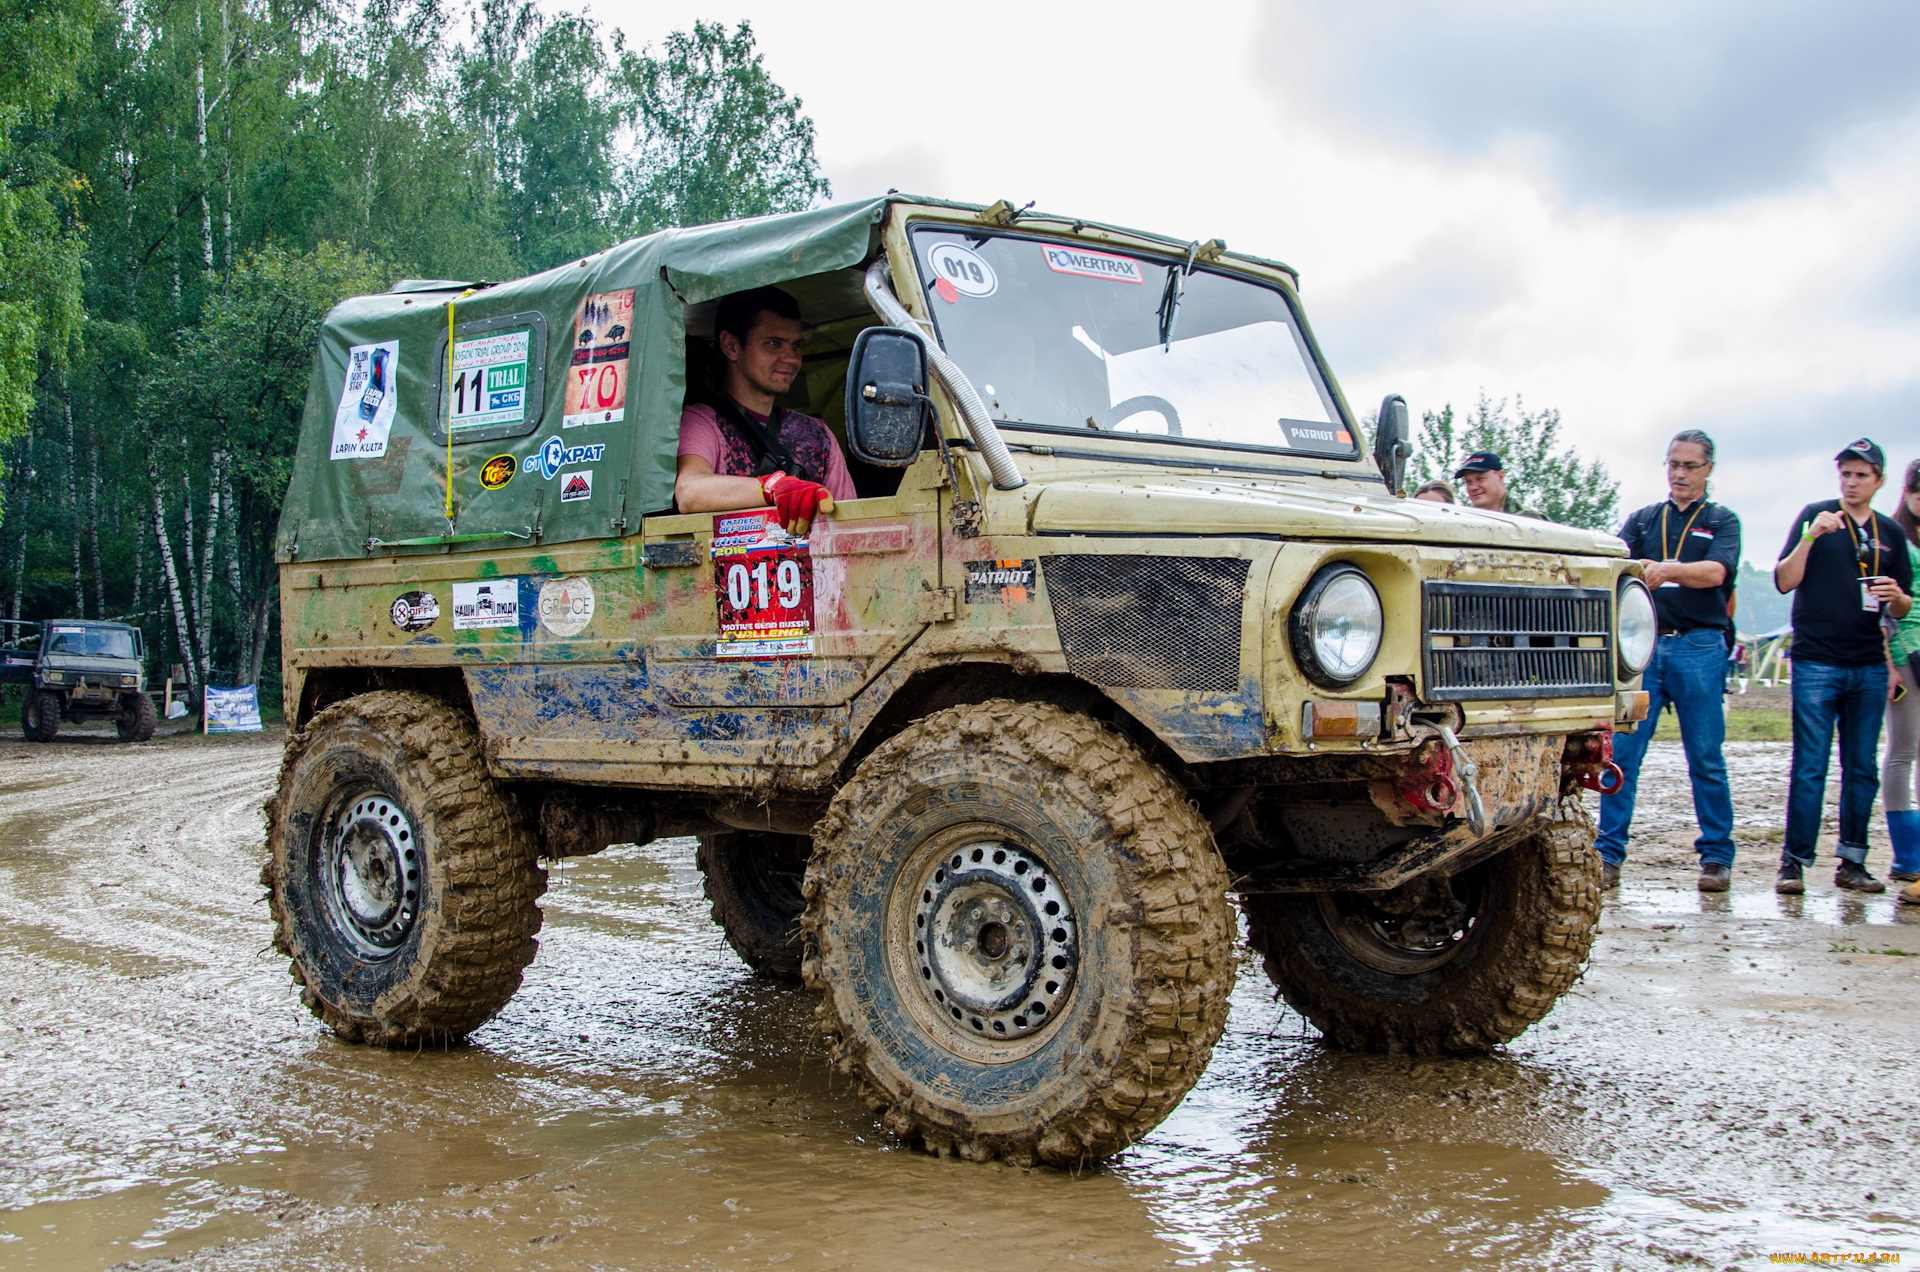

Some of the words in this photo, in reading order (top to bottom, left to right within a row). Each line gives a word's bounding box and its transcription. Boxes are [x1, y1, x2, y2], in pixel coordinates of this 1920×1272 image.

[1048, 250, 1134, 274] POWERTRAX
[944, 256, 984, 284] 019
[499, 335, 520, 343] TRIAL
[475, 346, 490, 357] TRIAL
[490, 342, 512, 355] GROUP
[513, 340, 528, 352] 2016
[354, 362, 362, 371] THE
[489, 368, 520, 389] TRIAL
[349, 381, 362, 391] STAR
[454, 369, 483, 414] 11
[578, 365, 618, 410] 70
[365, 388, 384, 399] LAPIN
[501, 391, 520, 403] СКБ
[1290, 428, 1334, 441] PATRIOT
[336, 443, 358, 453] LAPIN
[360, 442, 383, 452] KULTA
[720, 516, 762, 527] EXTREME
[716, 534, 759, 546] RACE
[715, 546, 747, 557] 2016
[969, 570, 1032, 584] PATRIOT
[728, 560, 801, 610] 019
[455, 605, 475, 617] НАШИ
[497, 602, 517, 616] ЛЮДИ
[222, 690, 253, 703] Motive
[229, 703, 253, 715] Gear
